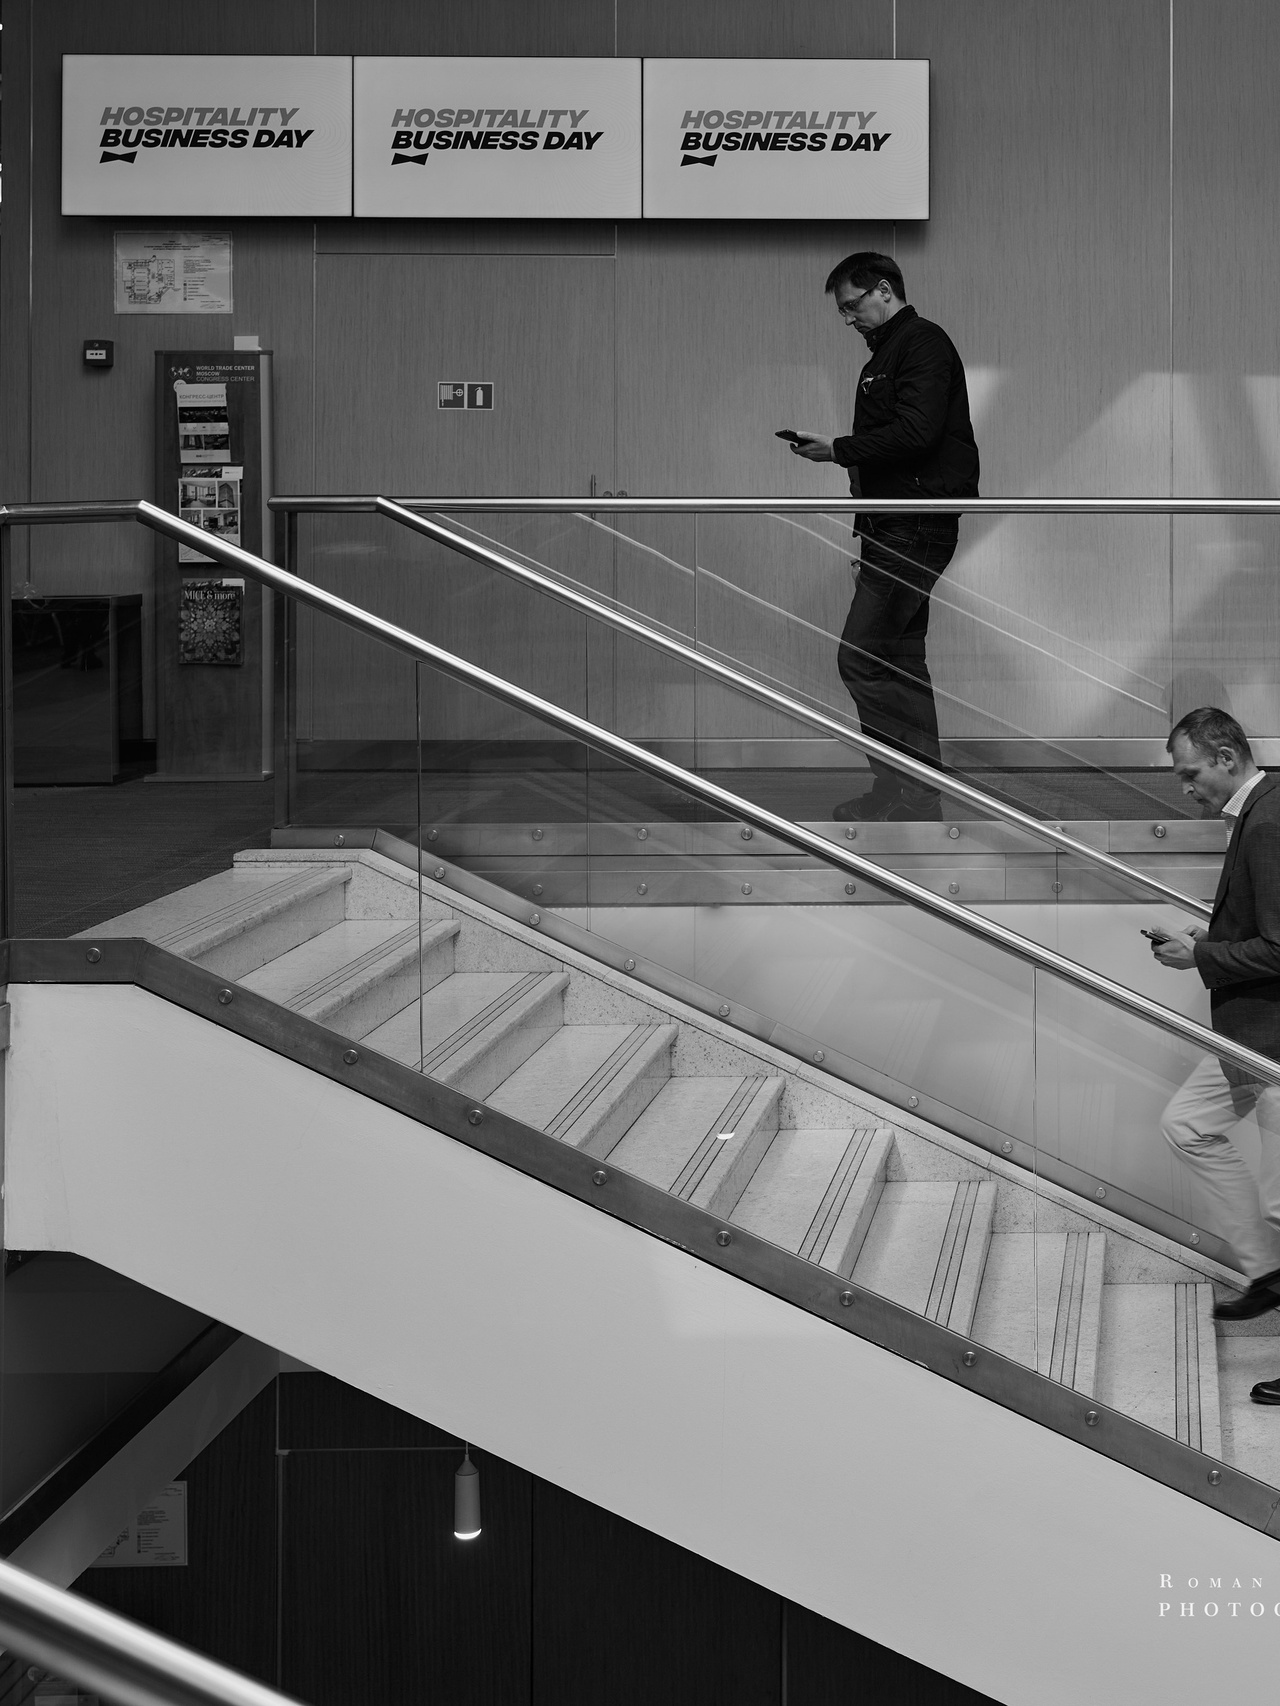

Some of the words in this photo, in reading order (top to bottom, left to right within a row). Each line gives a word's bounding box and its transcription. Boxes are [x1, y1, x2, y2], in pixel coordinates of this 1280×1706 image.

[100, 106, 300, 127] HOSPITALITY
[391, 108, 590, 128] HOSPITALITY
[680, 110, 878, 130] HOSPITALITY
[99, 128, 250, 149] BUSINESS
[252, 129, 315, 149] DAY
[391, 130, 540, 150] BUSINESS
[542, 131, 605, 150] DAY
[680, 132, 828, 151] BUSINESS
[830, 133, 892, 151] DAY
